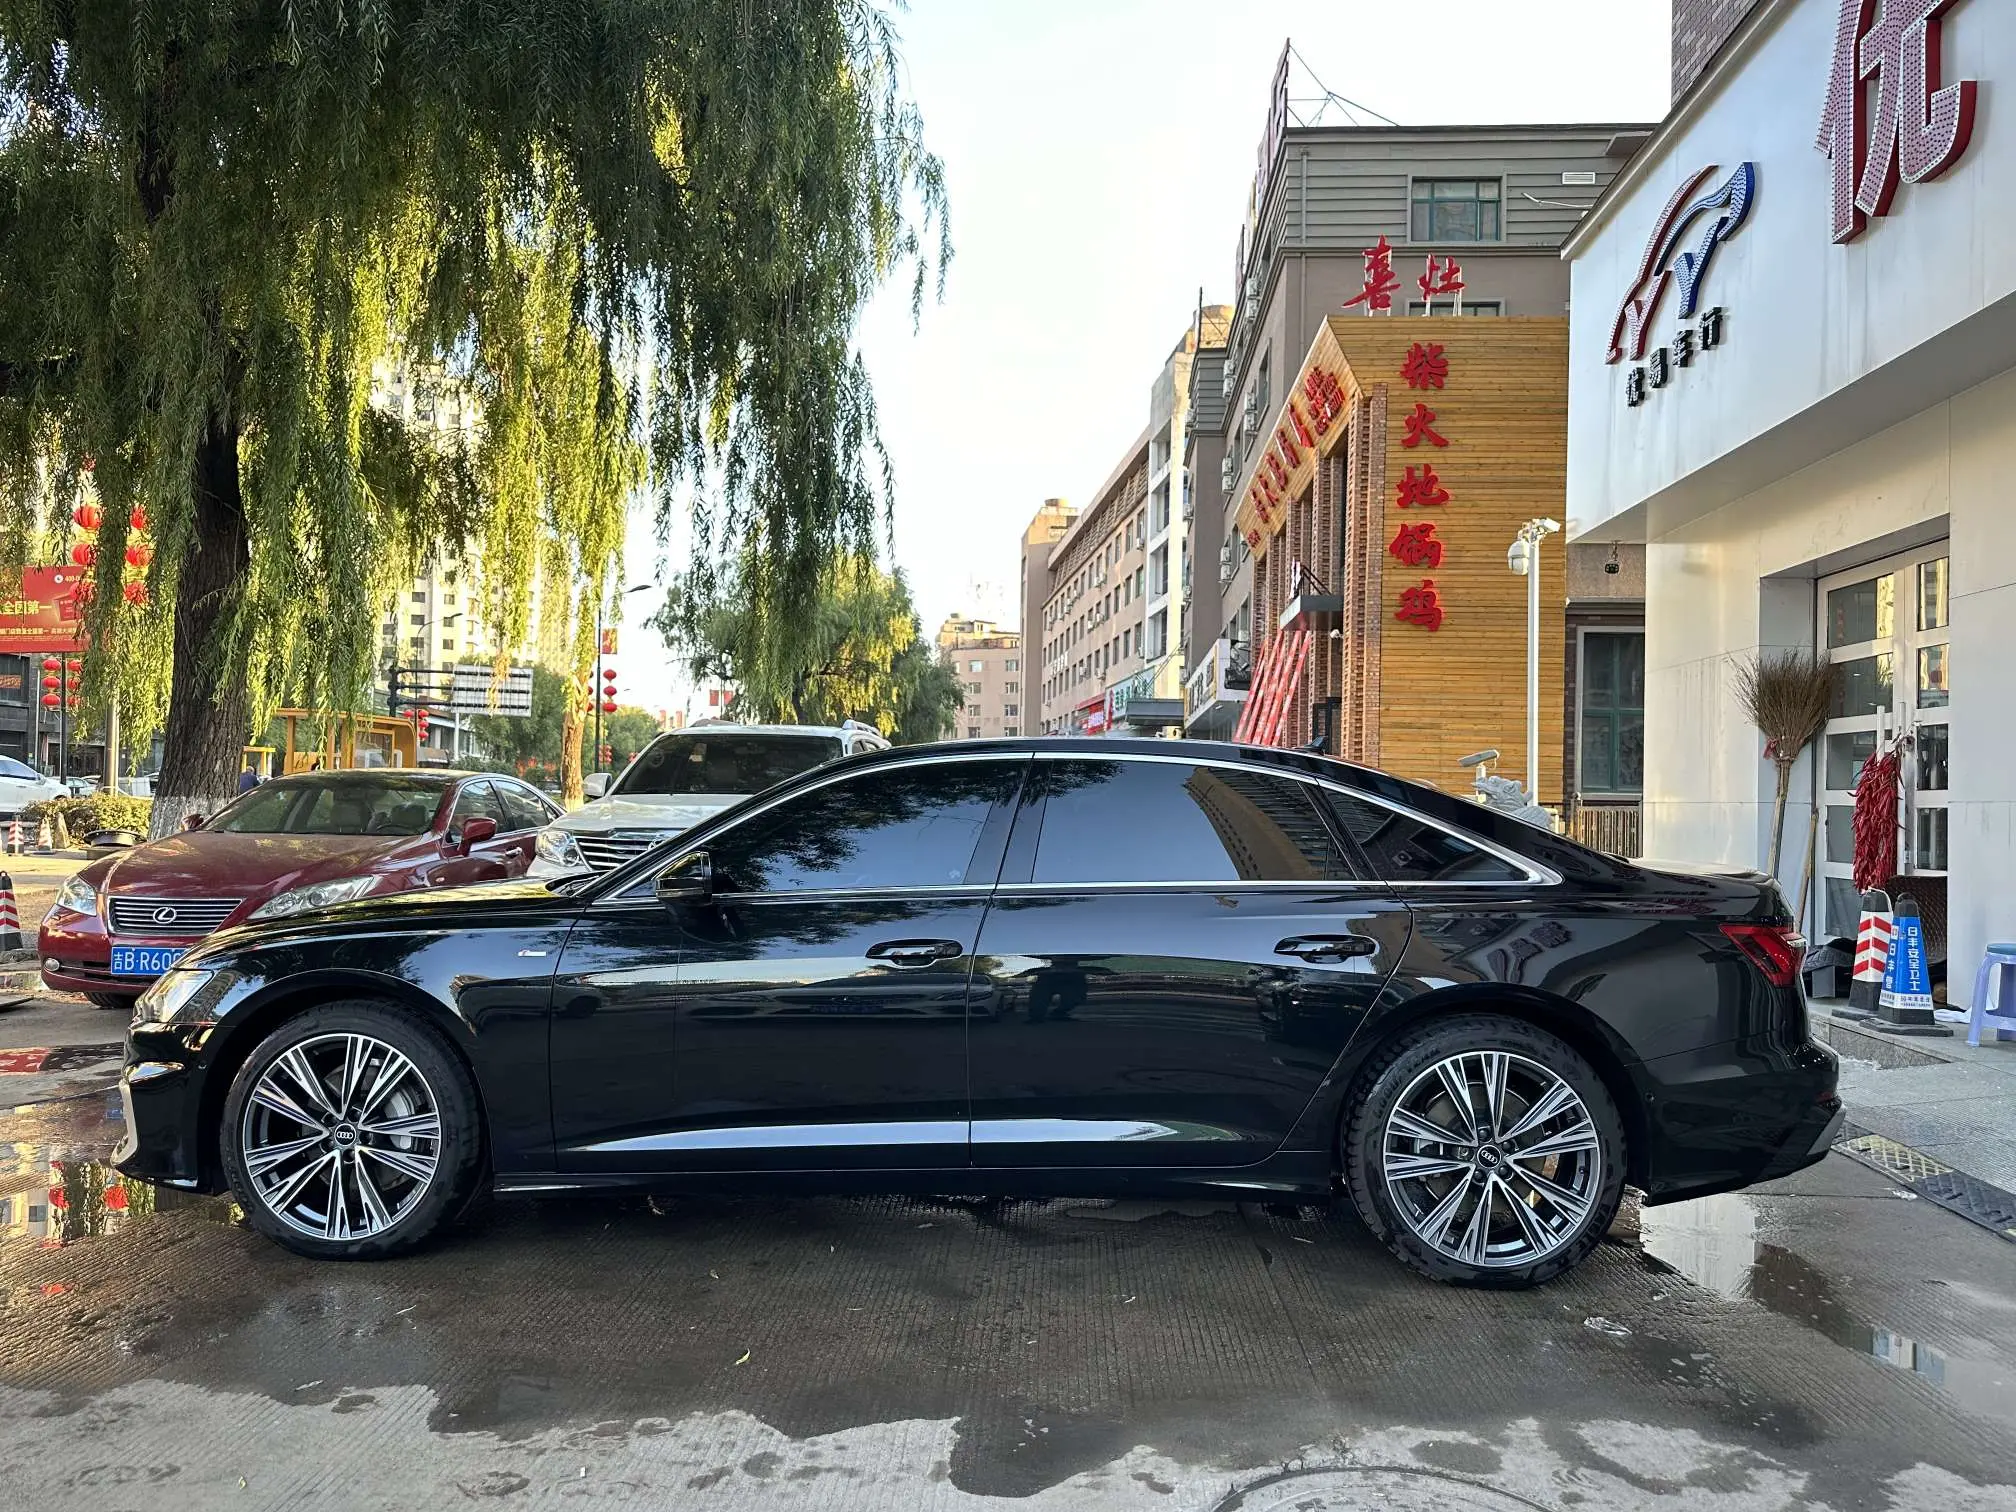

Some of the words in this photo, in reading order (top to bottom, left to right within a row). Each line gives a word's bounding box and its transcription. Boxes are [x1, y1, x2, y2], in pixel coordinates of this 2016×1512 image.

[1389, 341, 1450, 633] 柴火地锅鸡
[1907, 926, 1921, 991] 日丰安全卫士
